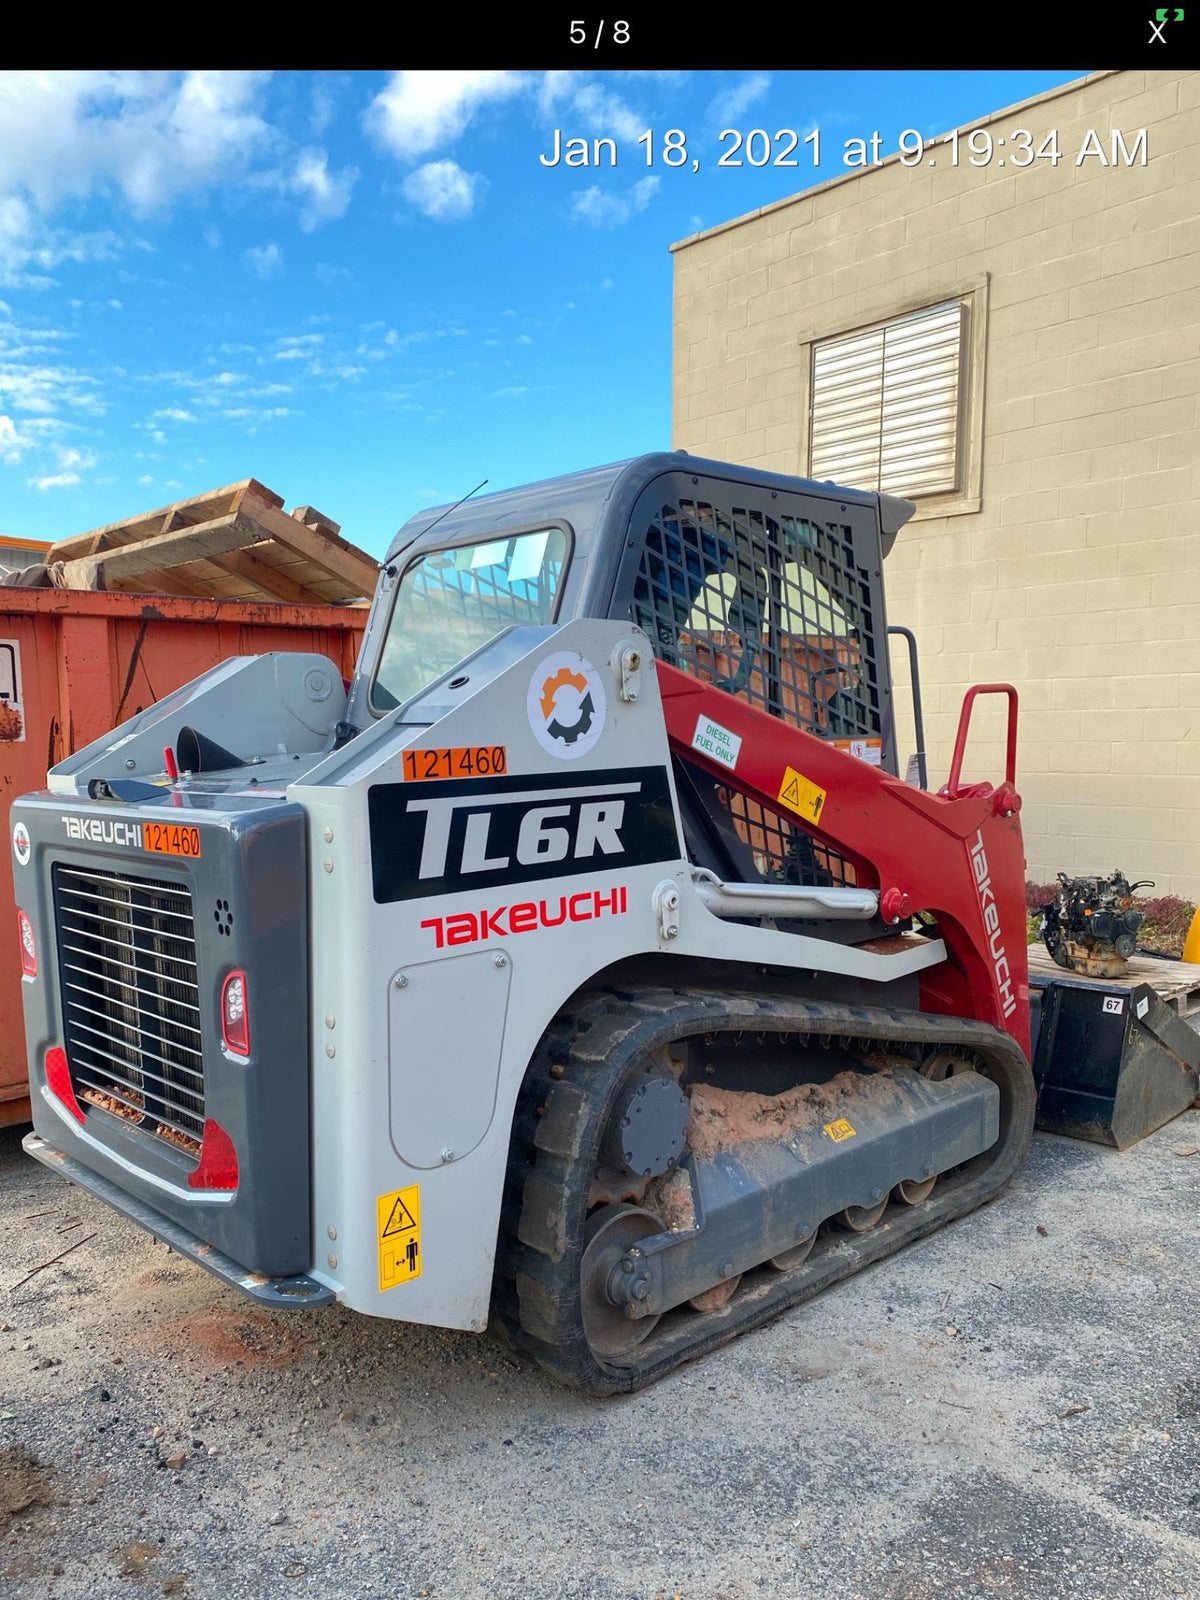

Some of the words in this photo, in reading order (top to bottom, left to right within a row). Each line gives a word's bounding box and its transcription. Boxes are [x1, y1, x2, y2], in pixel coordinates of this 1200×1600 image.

[695, 734, 714, 753] FUEL
[715, 745, 736, 763] ONLY
[706, 724, 731, 747] DIESEL
[405, 746, 507, 780] 121460
[61, 816, 142, 848] TAKEUCHI
[144, 826, 200, 856] 121460
[405, 781, 642, 880] TL6R
[420, 886, 628, 949] TAKEUCHI
[971, 828, 1017, 1019] TAKEUCHI
[1106, 999, 1121, 1011] 67
